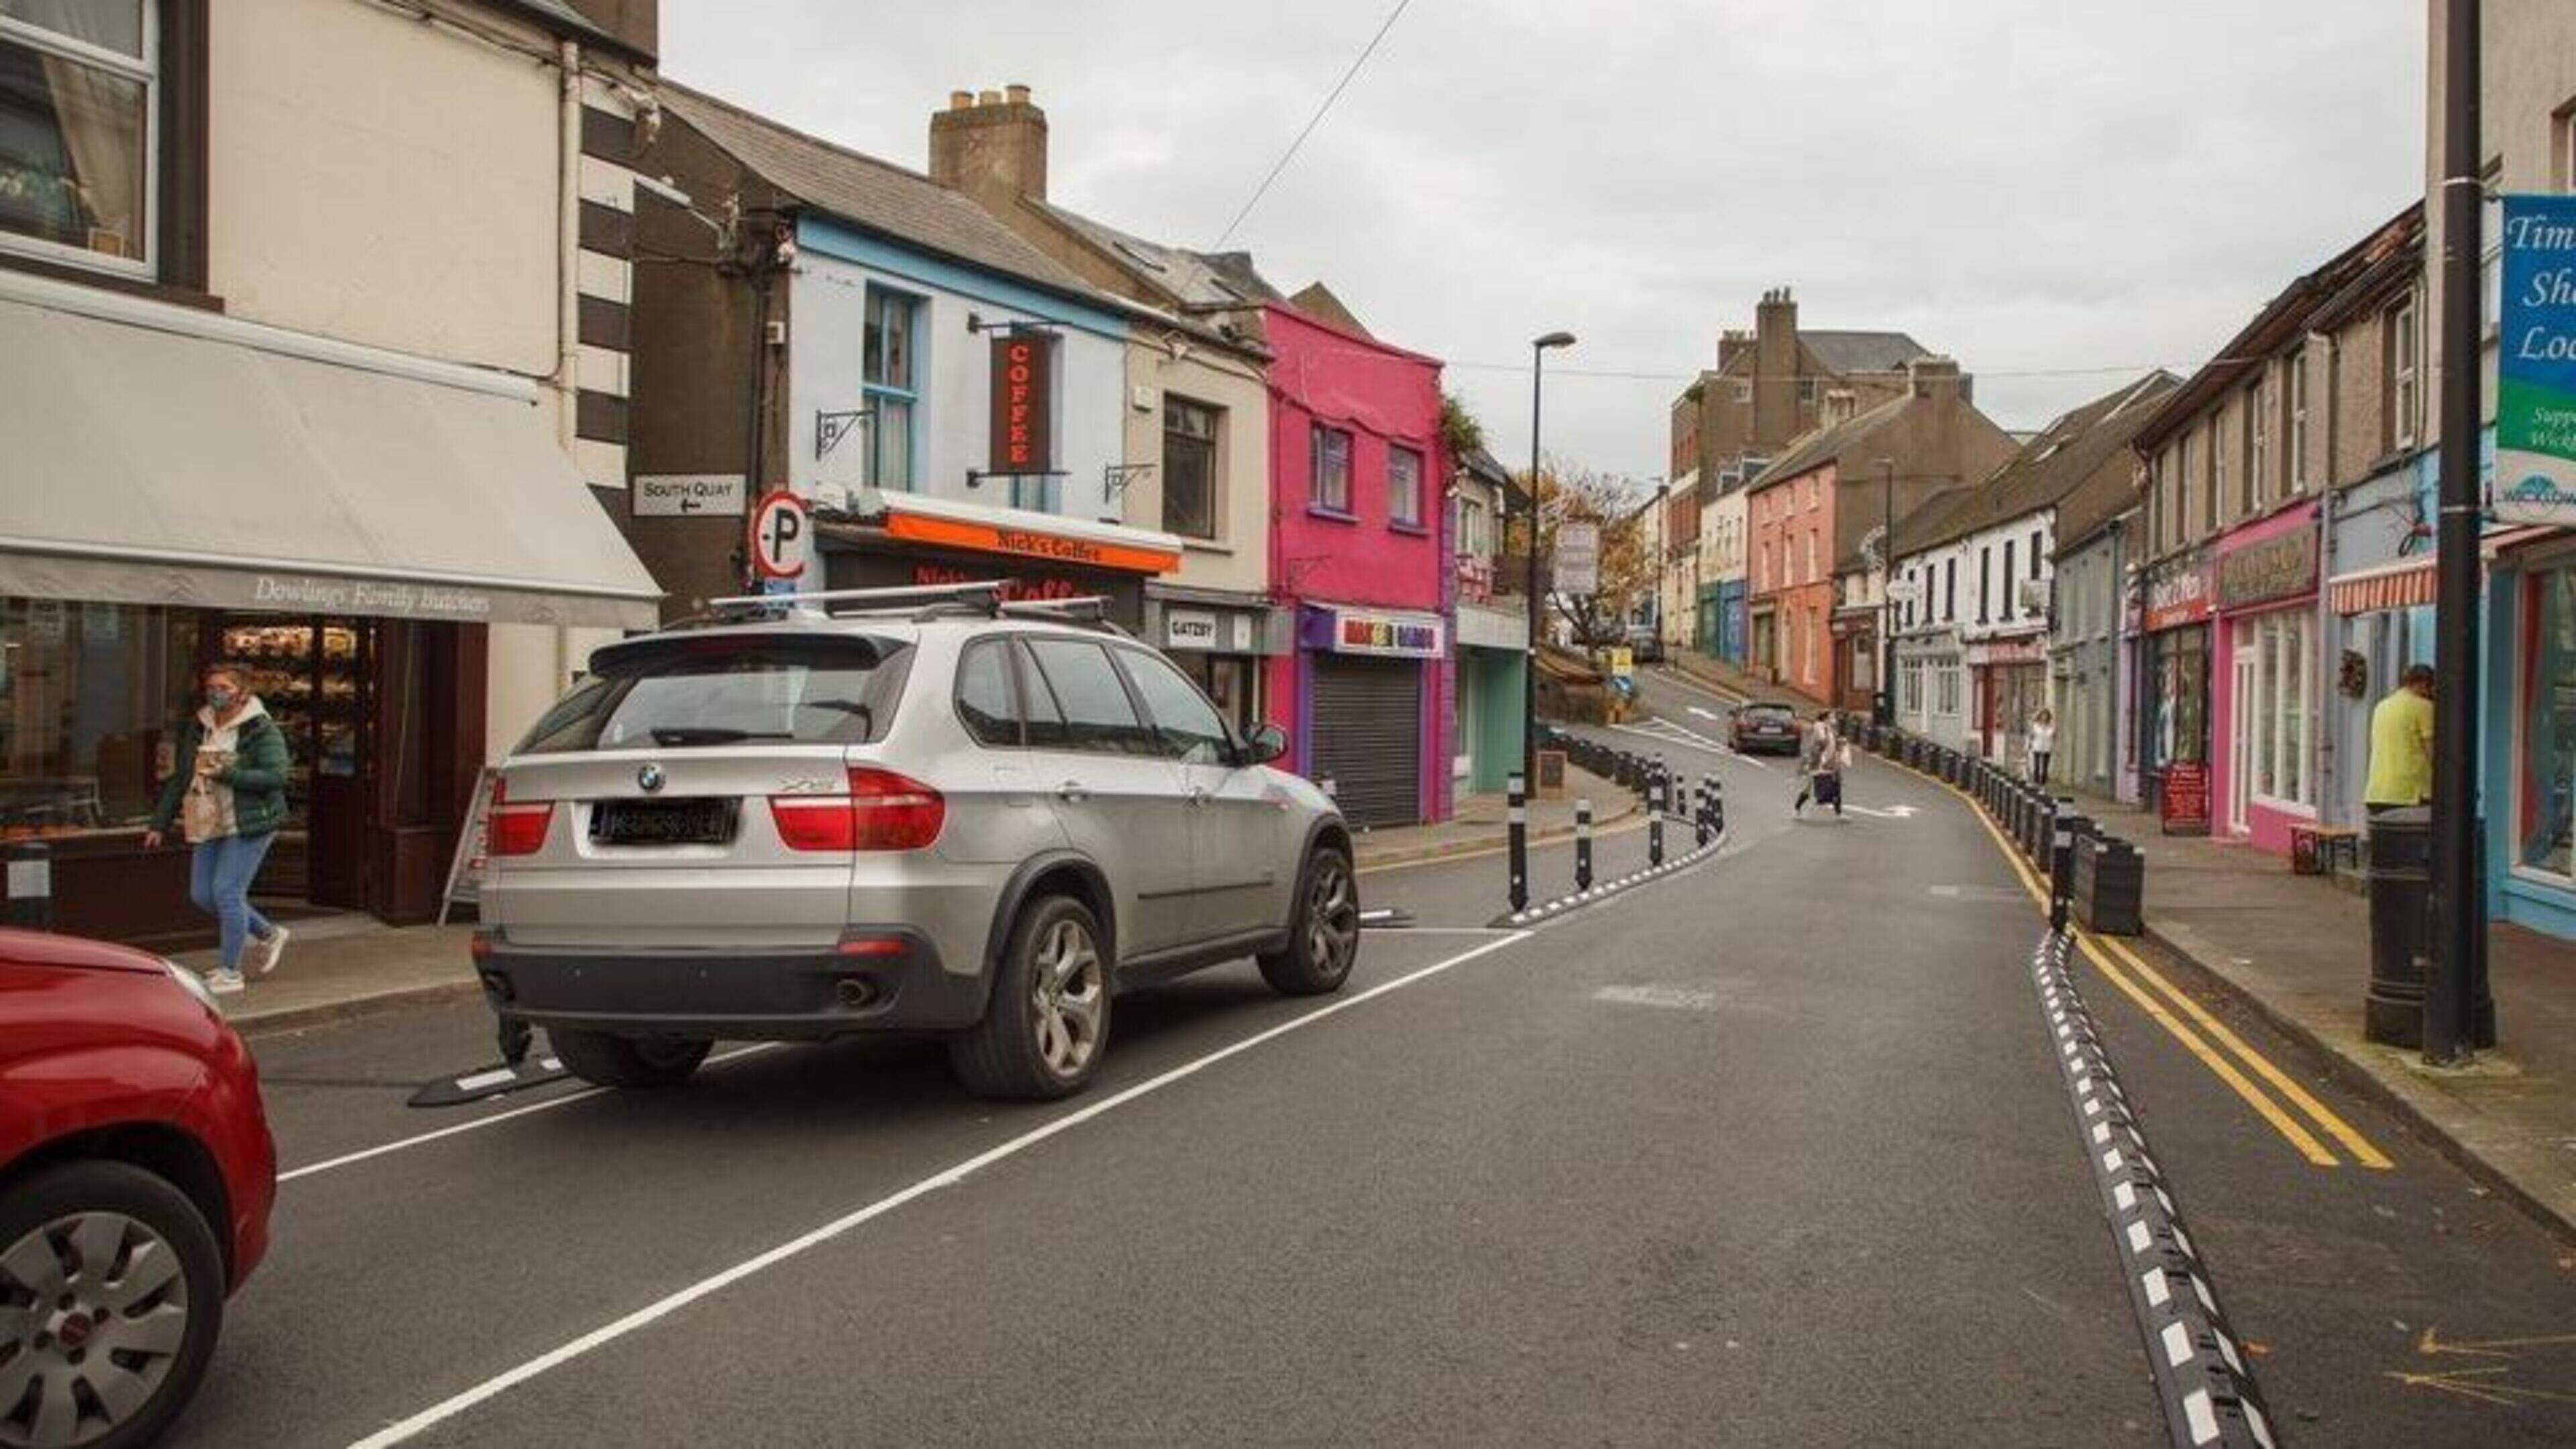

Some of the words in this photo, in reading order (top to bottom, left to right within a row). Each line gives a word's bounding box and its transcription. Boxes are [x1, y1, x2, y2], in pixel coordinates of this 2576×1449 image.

[2522, 268, 2576, 307] Sh
[1010, 344, 1029, 463] COFFEE
[773, 508, 799, 562] P
[353, 582, 415, 613] Family
